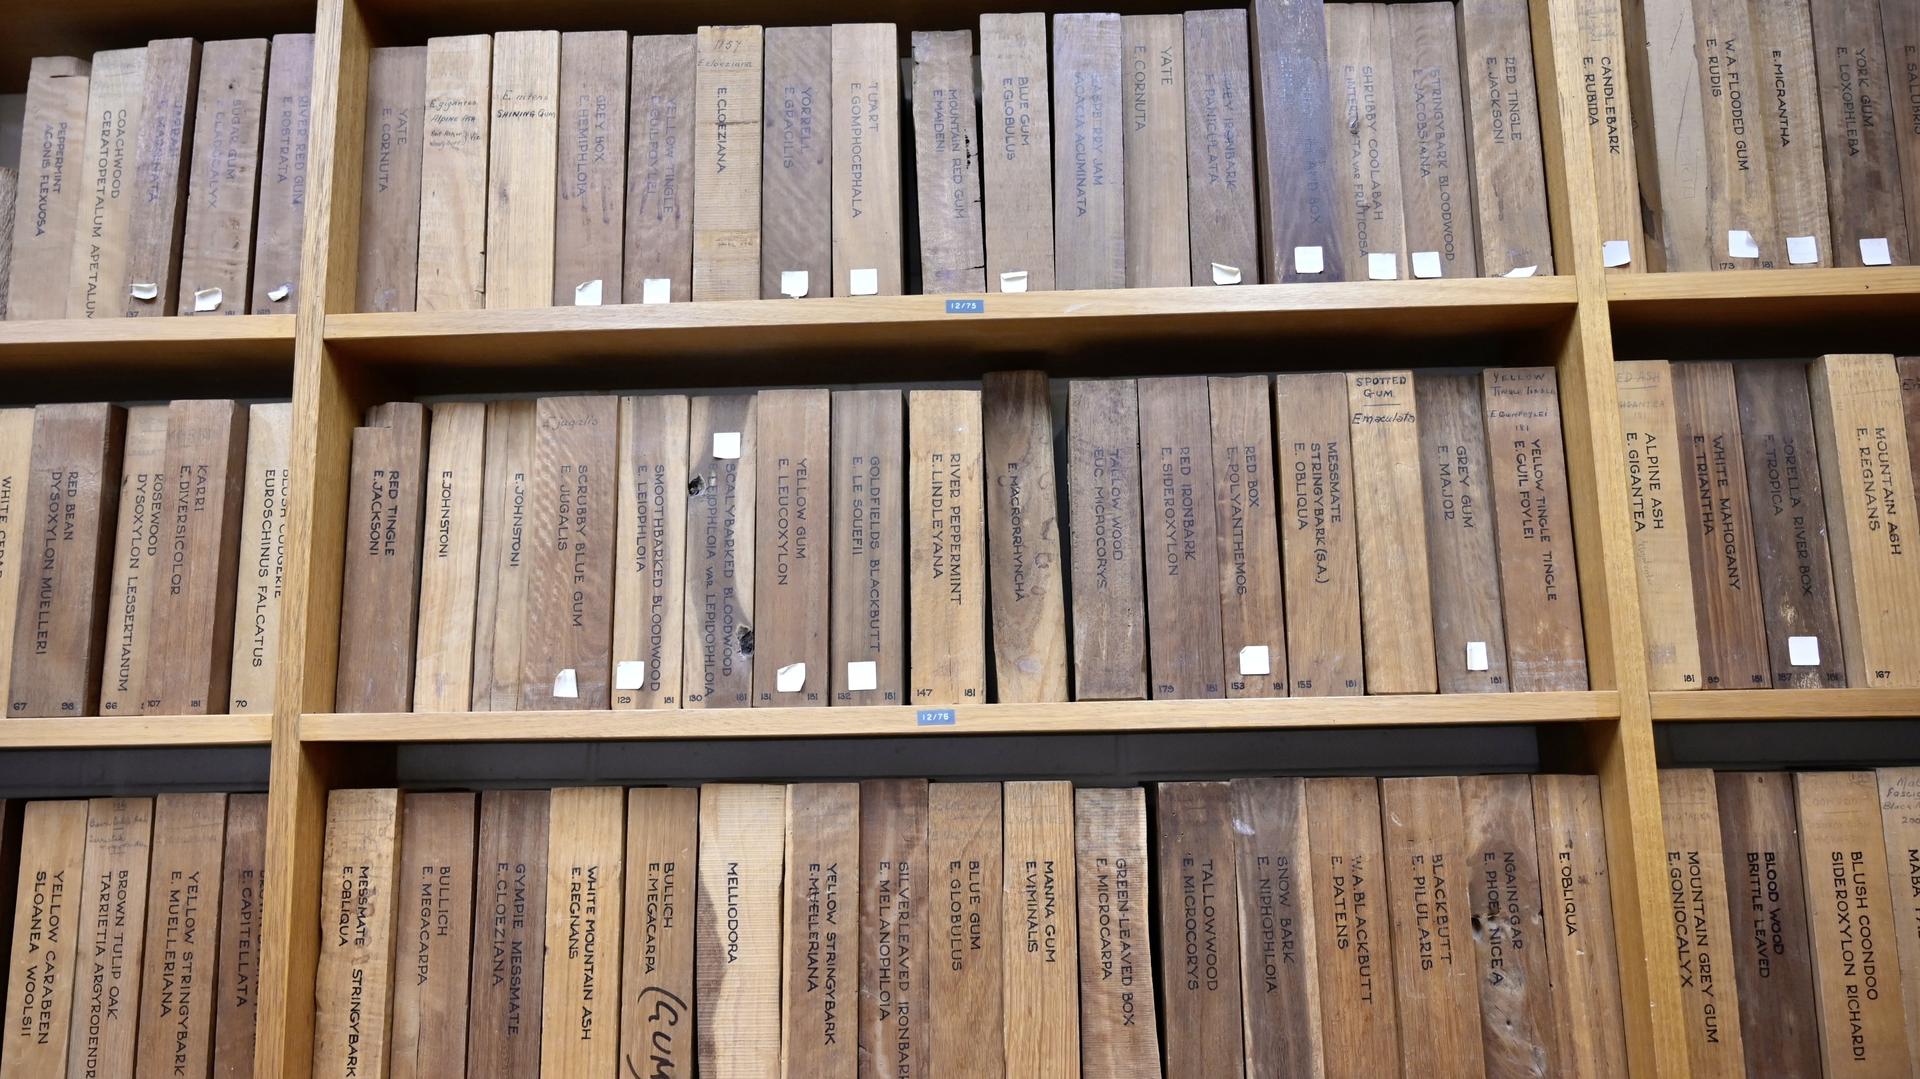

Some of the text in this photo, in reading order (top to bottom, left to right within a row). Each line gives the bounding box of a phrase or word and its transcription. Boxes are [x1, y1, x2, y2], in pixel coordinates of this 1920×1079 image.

[868, 82, 879, 132] TUART
[1018, 76, 1030, 146] BLUE GUM
[1160, 46, 1173, 86] YATE
[1504, 56, 1523, 141] RED TINGLE
[1601, 56, 1621, 155] CANDLEBARK
[1855, 49, 1874, 128] YORK GUM
[52, 122, 68, 194] PEPPERMINT
[111, 109, 127, 199] COACHWOOD
[397, 108, 408, 145] YATE
[497, 110, 535, 118] SHINING
[716, 86, 727, 174] E.CLOEZIANA
[948, 88, 965, 220] MOUNTAIN RED GUM
[1736, 140, 1750, 171] GUM
[35, 175, 50, 237] FLEXUOSA
[92, 110, 112, 238] CERATOPETALUM
[1075, 132, 1087, 217] ACUMINATA
[1366, 138, 1384, 221] COOLABAH
[1438, 175, 1456, 262] BLOODWOOD
[951, 301, 976, 310] 12/75
[1719, 262, 1736, 270] 173
[1356, 376, 1407, 387] SPOTTED
[63, 471, 78, 541] RED BEAN
[147, 473, 163, 556] ROSEWOOD
[194, 465, 208, 512] KARRI
[385, 470, 400, 556] RED TINGLE
[796, 458, 807, 560] YELLOW GUM
[1179, 447, 1196, 561] RED IRONBARK
[1245, 446, 1259, 508] RED BOX
[1311, 443, 1326, 546] STRINGYBARK
[1327, 442, 1341, 523] MESSMATE
[1456, 446, 1474, 528] GREY GUM
[1530, 439, 1557, 601] YELLOW TINGLE TINGLE
[1645, 433, 1664, 530] ALPINE ASH
[1712, 436, 1741, 591] WHITE MAHOGANY
[1874, 428, 1902, 556] MOUNTAIN ASH
[35, 471, 62, 655] DYSOXYLON MUELLERI
[252, 469, 275, 667] EUROSCHINUS FALCATUS
[572, 465, 588, 627] SCRUBBY BLUE GUM
[869, 456, 881, 652] GOLDFIELDS BLACKBUTT
[950, 453, 962, 606] RIVER PEPPERMINT
[1112, 518, 1123, 561] WOOD
[118, 473, 147, 692] DYSOXYLON LESSERTIANUM
[650, 464, 665, 692] SMOOTHBARKED BLOODWOOD
[1799, 565, 1813, 597] BOX
[722, 587, 733, 677] BLOODWOOD
[1876, 671, 1891, 679] 167
[13, 702, 27, 711] 67
[236, 700, 248, 708] 70
[917, 688, 932, 697] 147
[964, 688, 976, 697] 181
[95, 871, 112, 957] TARRIETIA
[437, 866, 450, 936] BULLICH
[663, 862, 675, 929] BULLICH
[728, 862, 739, 964] MELLIODORA
[969, 861, 981, 950] BLUE GUM
[1044, 861, 1056, 963] MANNA GUM
[1277, 856, 1295, 964] SNOW BARK
[1432, 854, 1451, 965] BLACKBUTT
[1504, 852, 1523, 950] NGAINGGAR
[1747, 853, 1770, 979] BRITTLE LEAVED
[1764, 852, 1784, 955] BLOOD WOOD
[1851, 852, 1868, 909] BLUSH
[1908, 849, 1920, 898] MABA
[22, 871, 46, 1036] SLOANEA WOOLSII
[39, 871, 64, 1044] YELLOW CARABEEN
[108, 870, 128, 1021] BROWN TULIP OAK
[508, 863, 526, 1035] GYMPIE MESSMATE
[581, 865, 598, 1041] WHITE MOUNTAIN ASH
[824, 862, 838, 1045] YELLOW STRINGYBARK
[898, 862, 910, 992] SILVERLEAVED
[1116, 858, 1135, 1026] GREEN-LEAVED BOX
[1202, 859, 1218, 991] TALLOWWOOD
[1687, 851, 1720, 1044] MOUNTAIN GREY GUM
[1832, 852, 1856, 976] SIDEROXYLON
[1846, 984, 1866, 1061] RICHARDI
[1858, 915, 1878, 1001] COONDOO
[174, 871, 200, 1077] YELLOW STRINGYBARK
[346, 866, 369, 1078] MESSMATE STRINGYBARK
